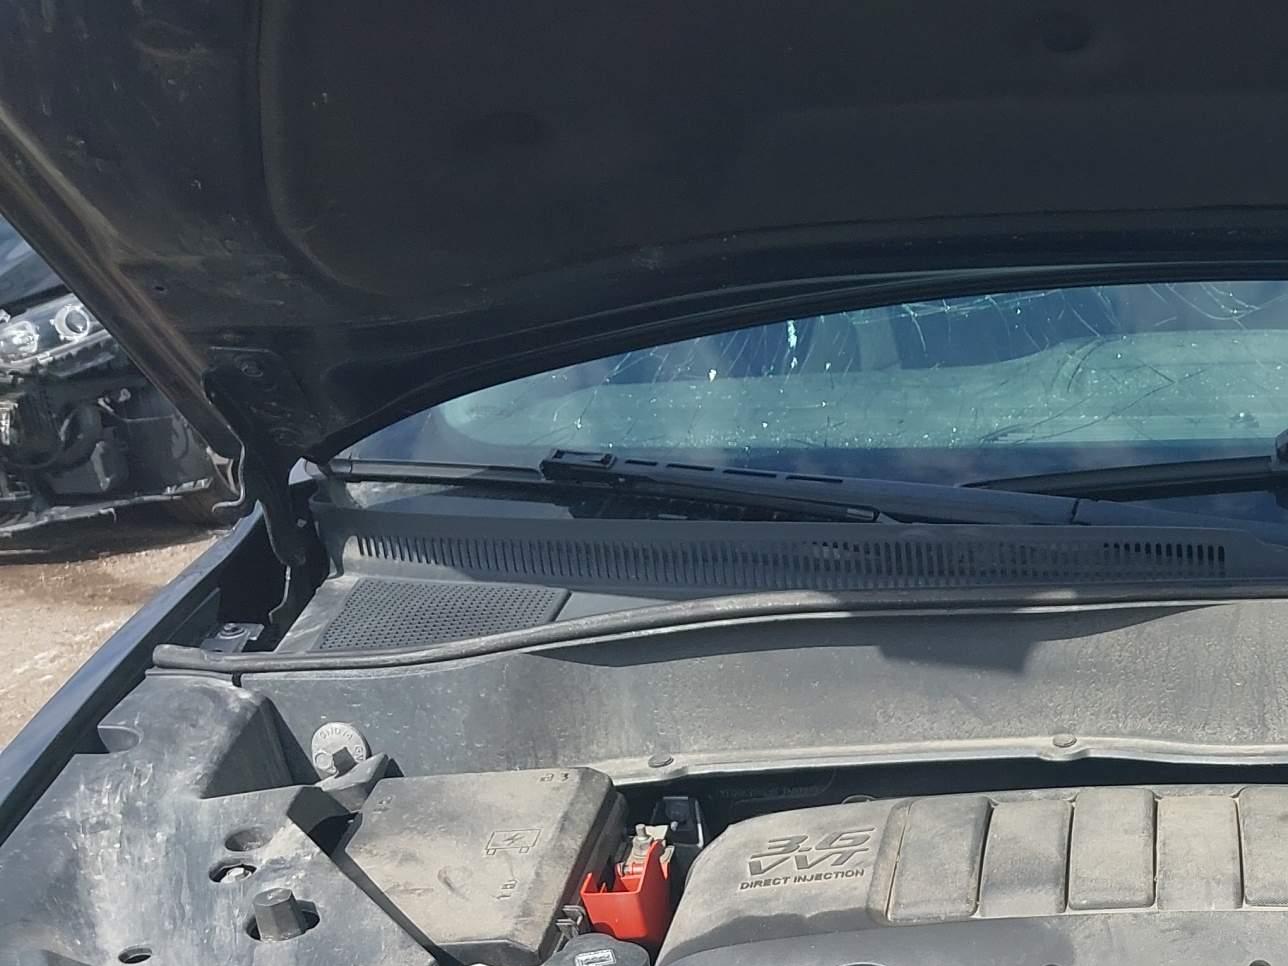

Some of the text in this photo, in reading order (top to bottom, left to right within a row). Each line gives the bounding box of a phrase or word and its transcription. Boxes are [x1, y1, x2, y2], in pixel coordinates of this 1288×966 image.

[767, 827, 875, 853] 3.6
[748, 847, 869, 876] VVT
[739, 869, 865, 890] DIRECT INJECTION
